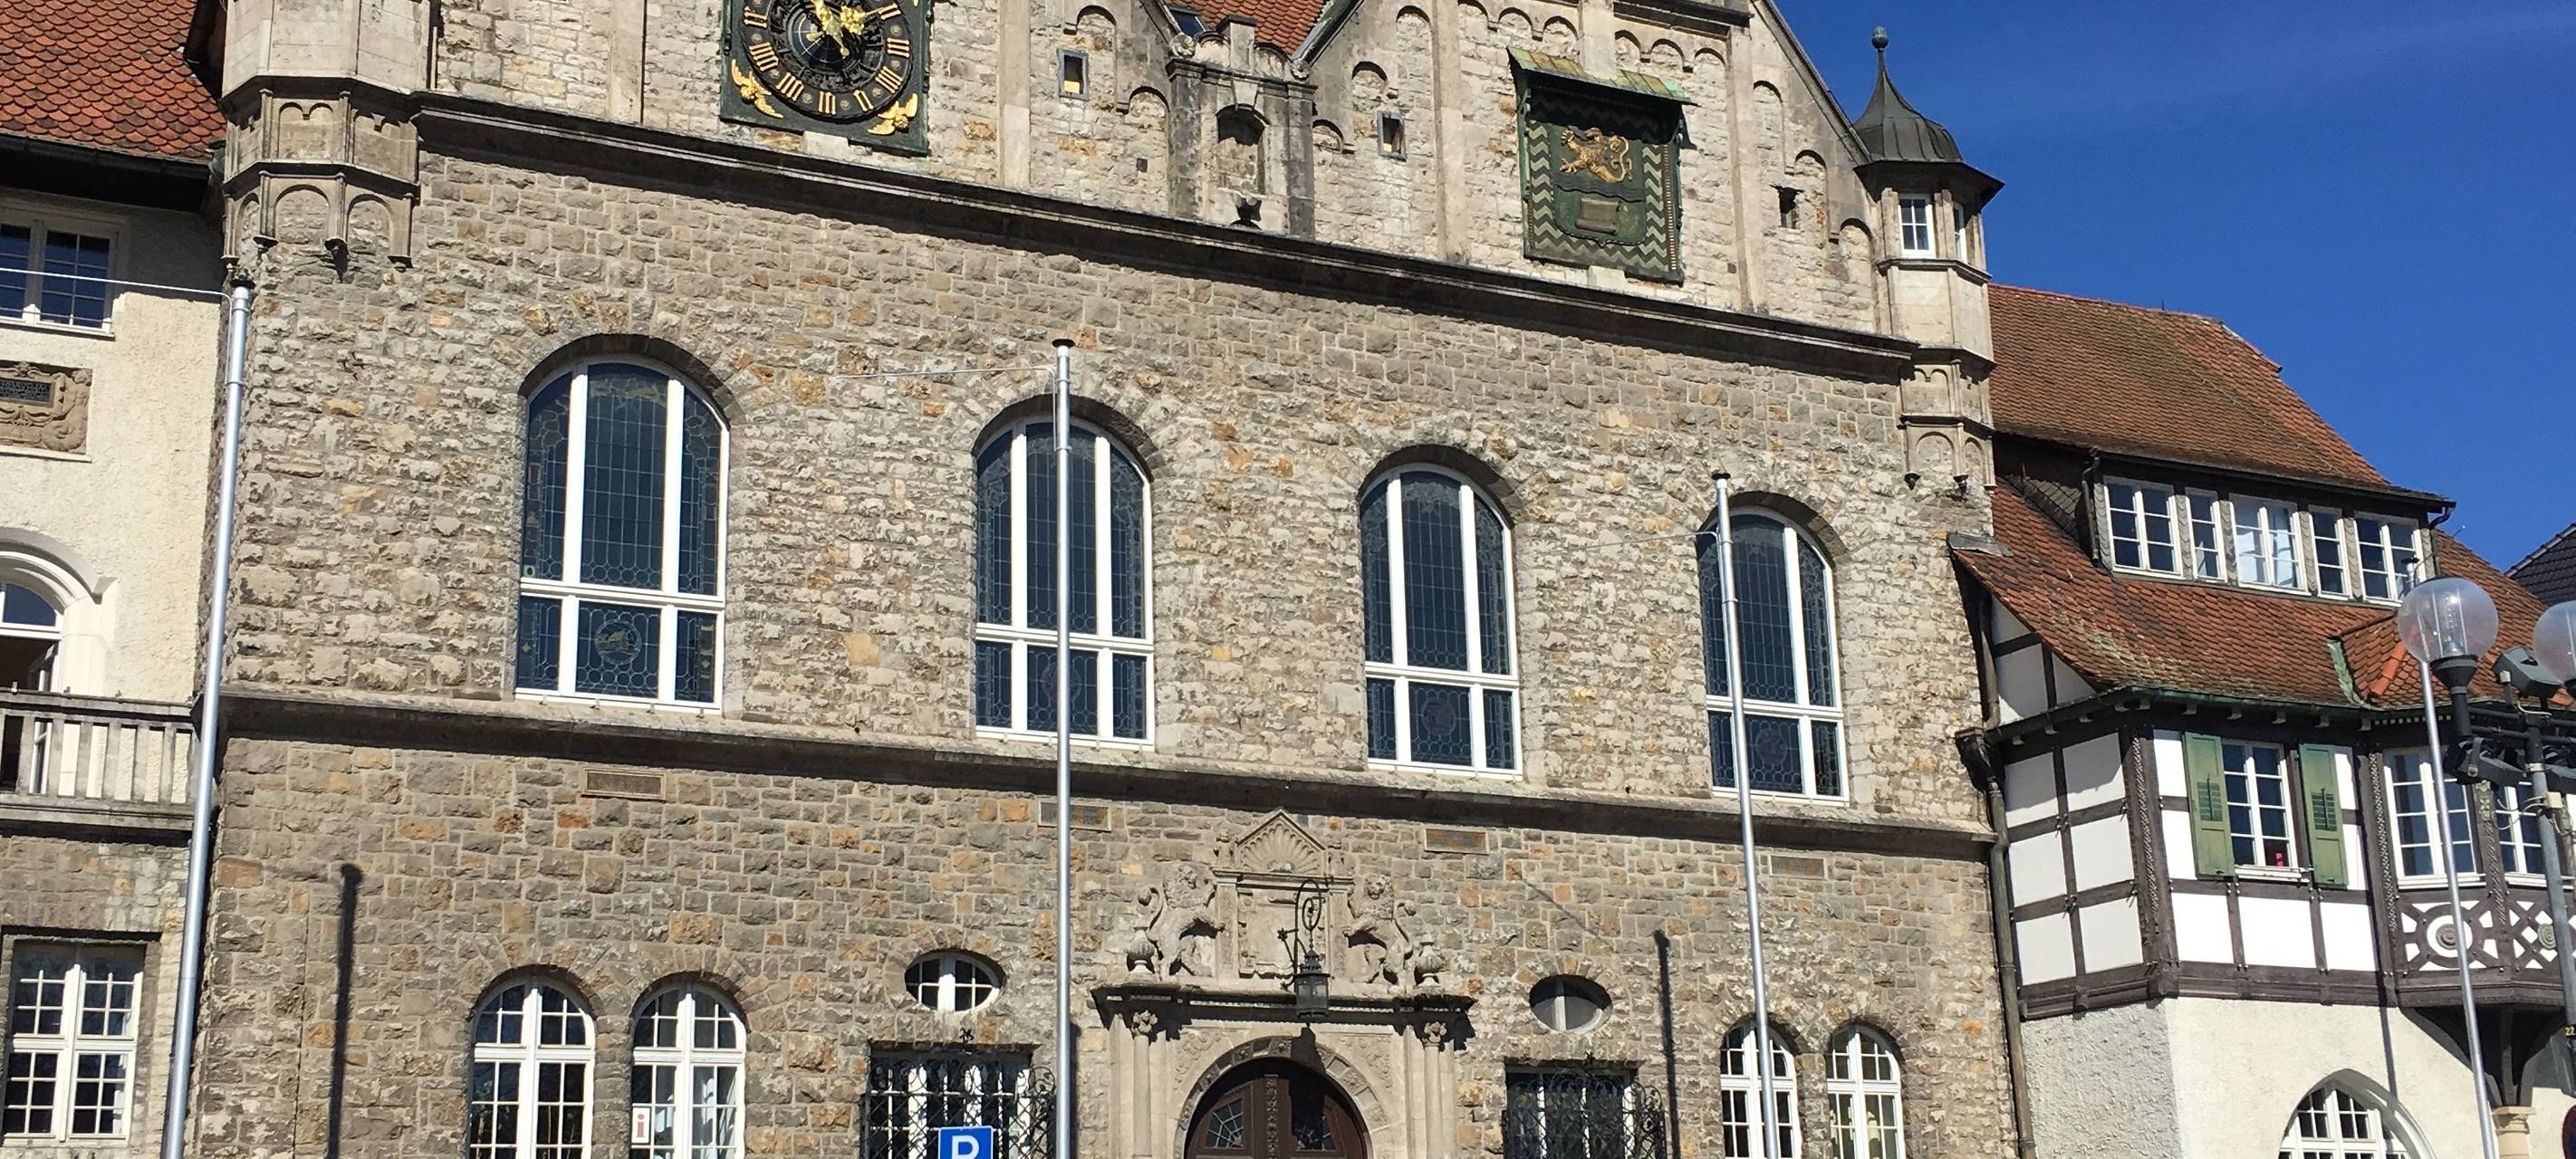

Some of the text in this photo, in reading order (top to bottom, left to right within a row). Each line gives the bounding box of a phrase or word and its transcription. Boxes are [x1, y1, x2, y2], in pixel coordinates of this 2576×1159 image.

[749, 42, 779, 72] VIII
[887, 37, 910, 58] III
[776, 72, 804, 101] VII
[875, 66, 904, 94] IIII
[952, 1135, 979, 1159] P
